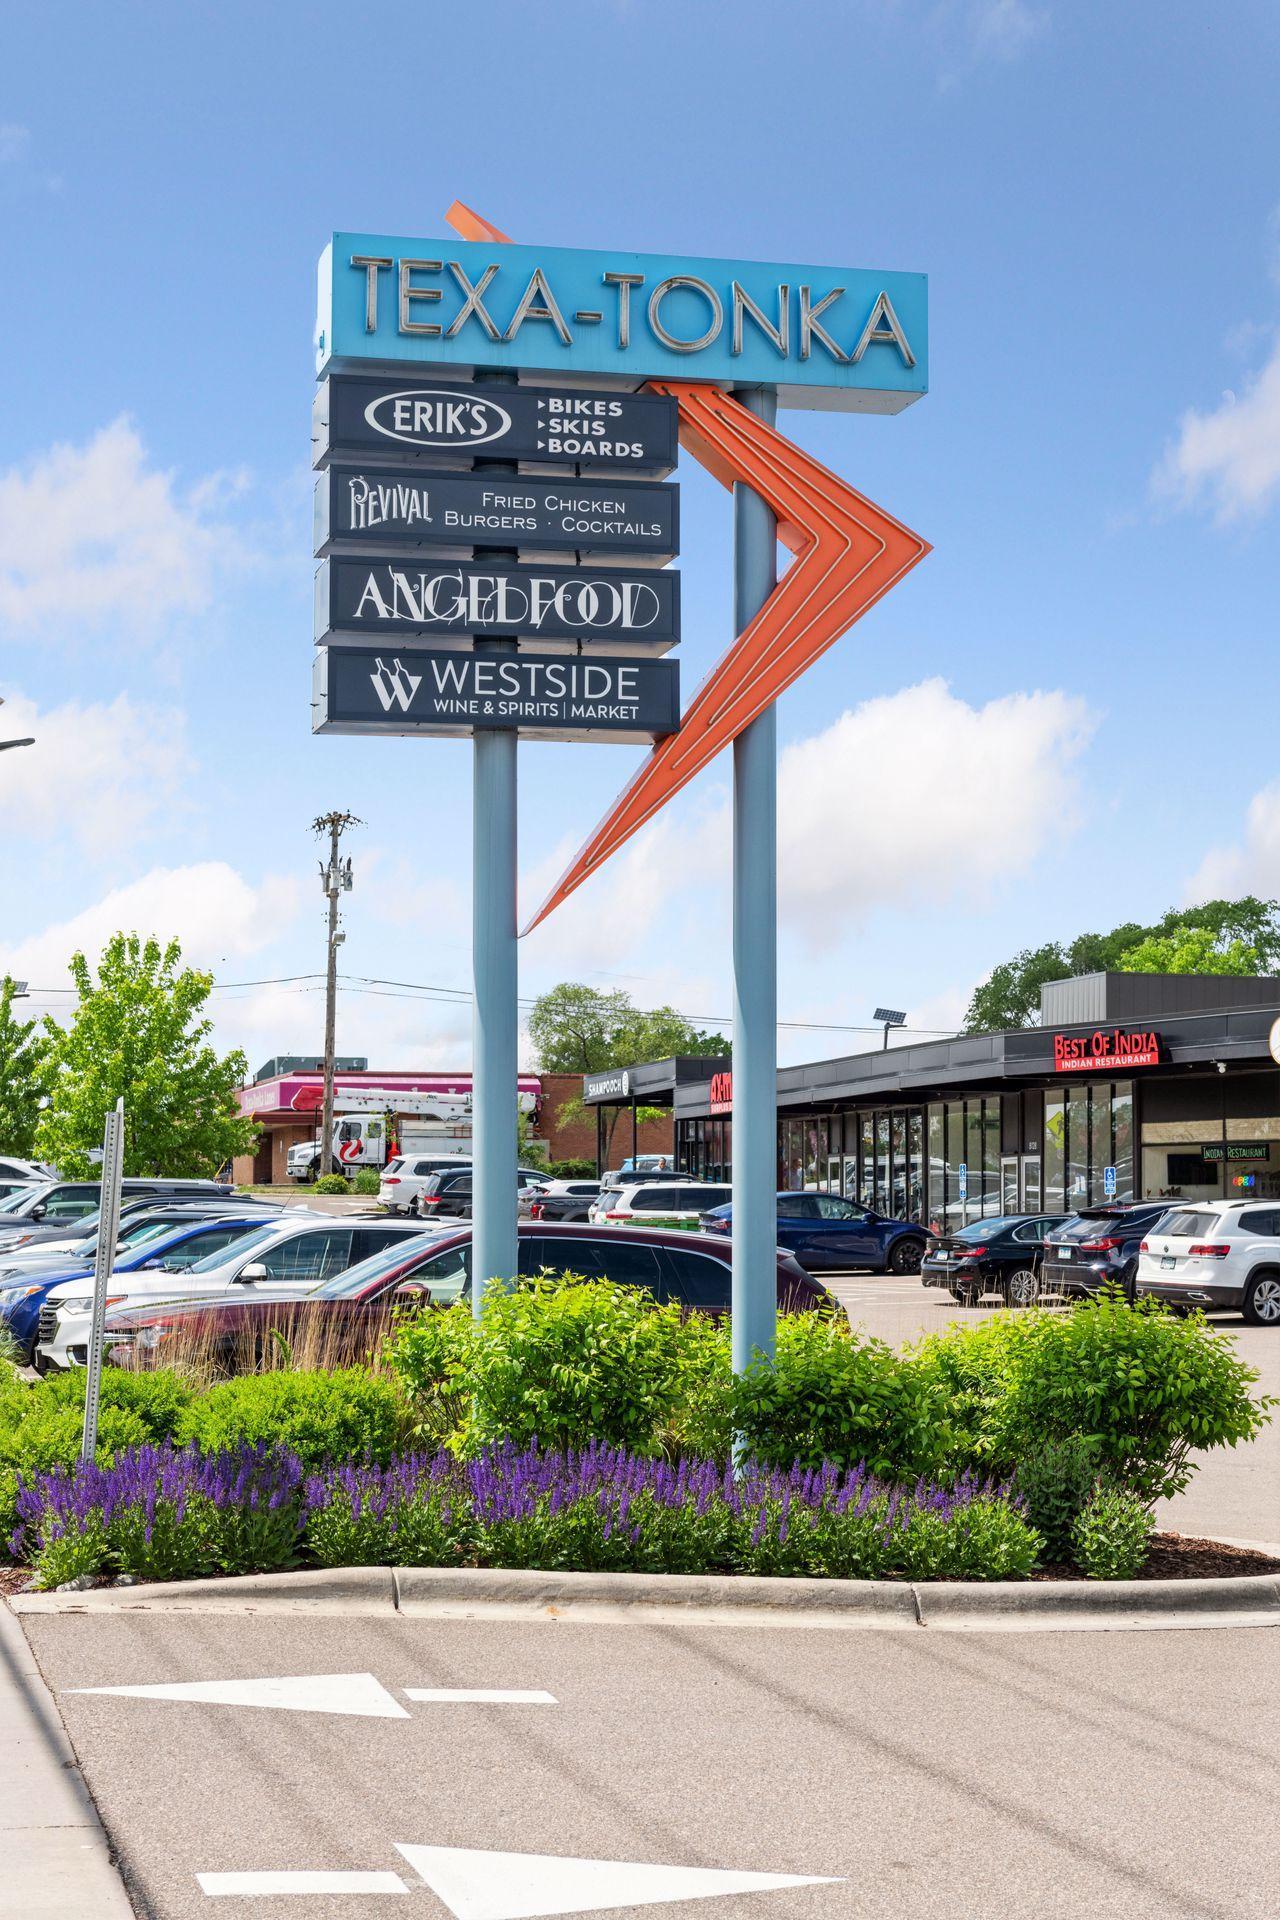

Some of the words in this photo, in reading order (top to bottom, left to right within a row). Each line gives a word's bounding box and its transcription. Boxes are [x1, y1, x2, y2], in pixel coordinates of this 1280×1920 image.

[351, 255, 916, 369] TEXA-TONKA
[393, 399, 488, 436] ERIK'S
[549, 399, 623, 417] BIKES
[549, 418, 606, 435] SKIS
[549, 439, 644, 458] BOARDS
[349, 476, 433, 529] REVIVAL
[431, 660, 639, 700] WESTSIDE
[434, 699, 479, 714] WINE
[483, 701, 494, 715] &
[499, 702, 558, 717] SPIRITS
[571, 704, 639, 719] MARKET
[1062, 1059, 1092, 1069] INDIAN
[1095, 1054, 1151, 1066] RESTAURANT
[589, 1079, 621, 1096] SHAMPOOCH
